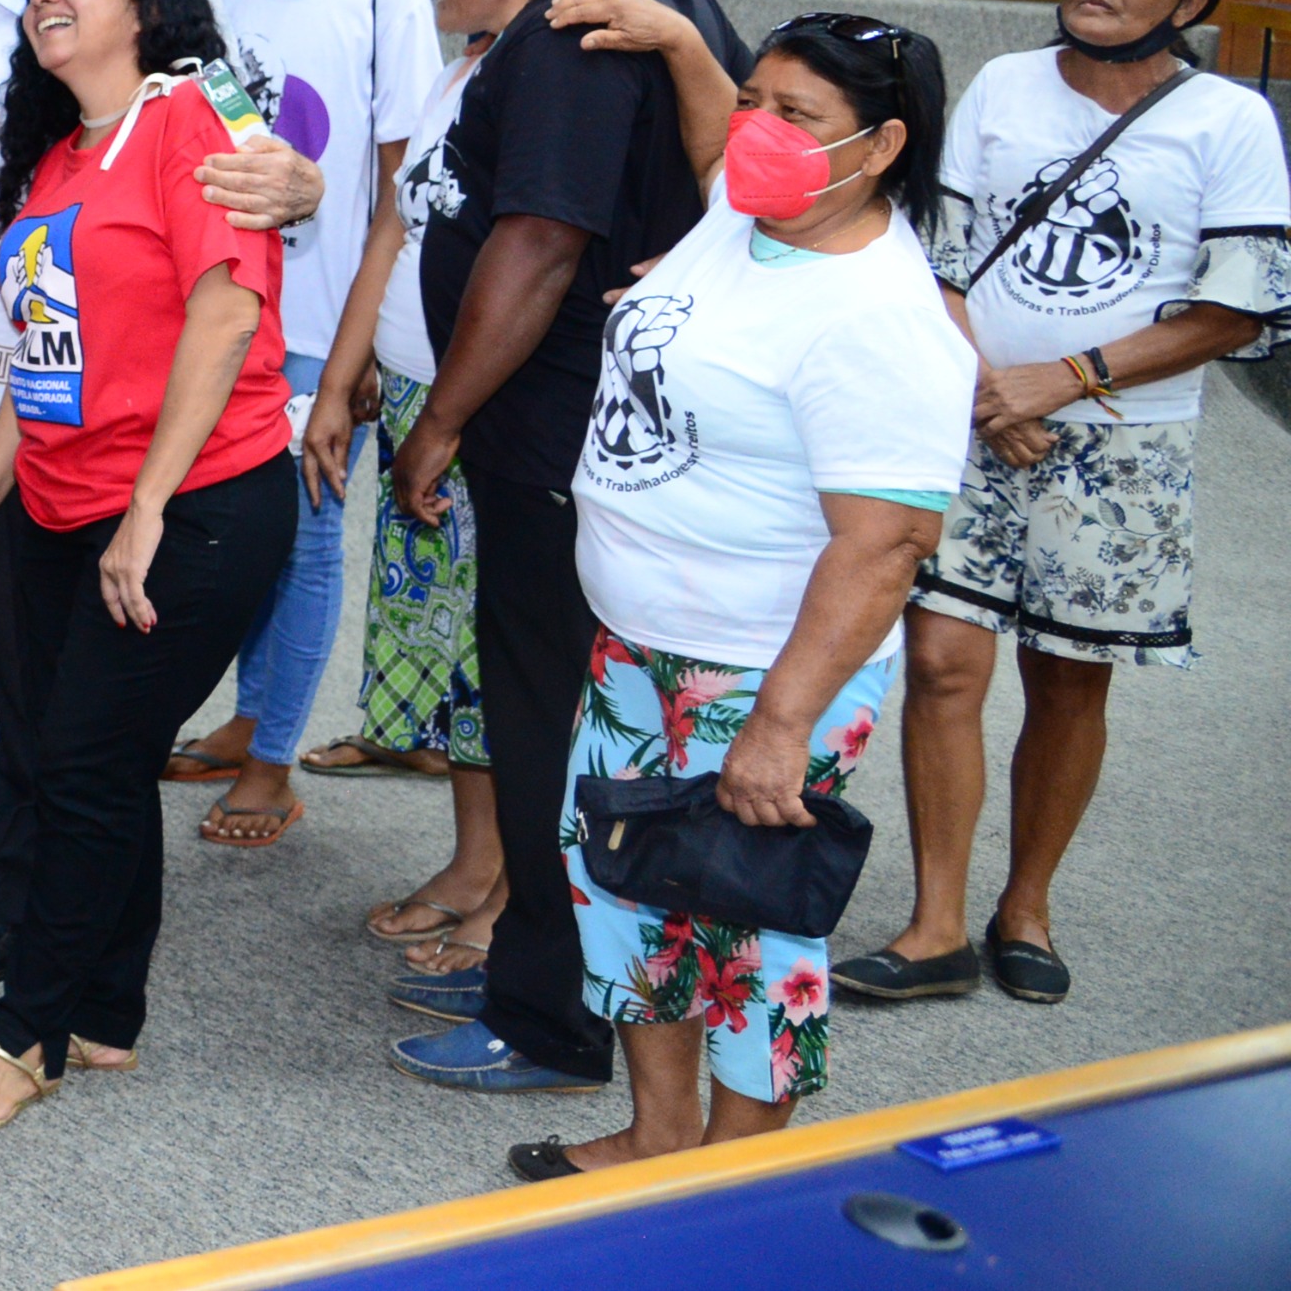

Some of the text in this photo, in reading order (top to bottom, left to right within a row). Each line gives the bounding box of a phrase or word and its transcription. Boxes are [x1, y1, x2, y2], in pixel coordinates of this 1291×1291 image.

[1046, 306, 1054, 315] e
[1058, 279, 1145, 316] Trabalhadores
[1148, 223, 1161, 267] Direitos
[596, 476, 602, 485] e
[606, 457, 698, 492] Trabalhadores
